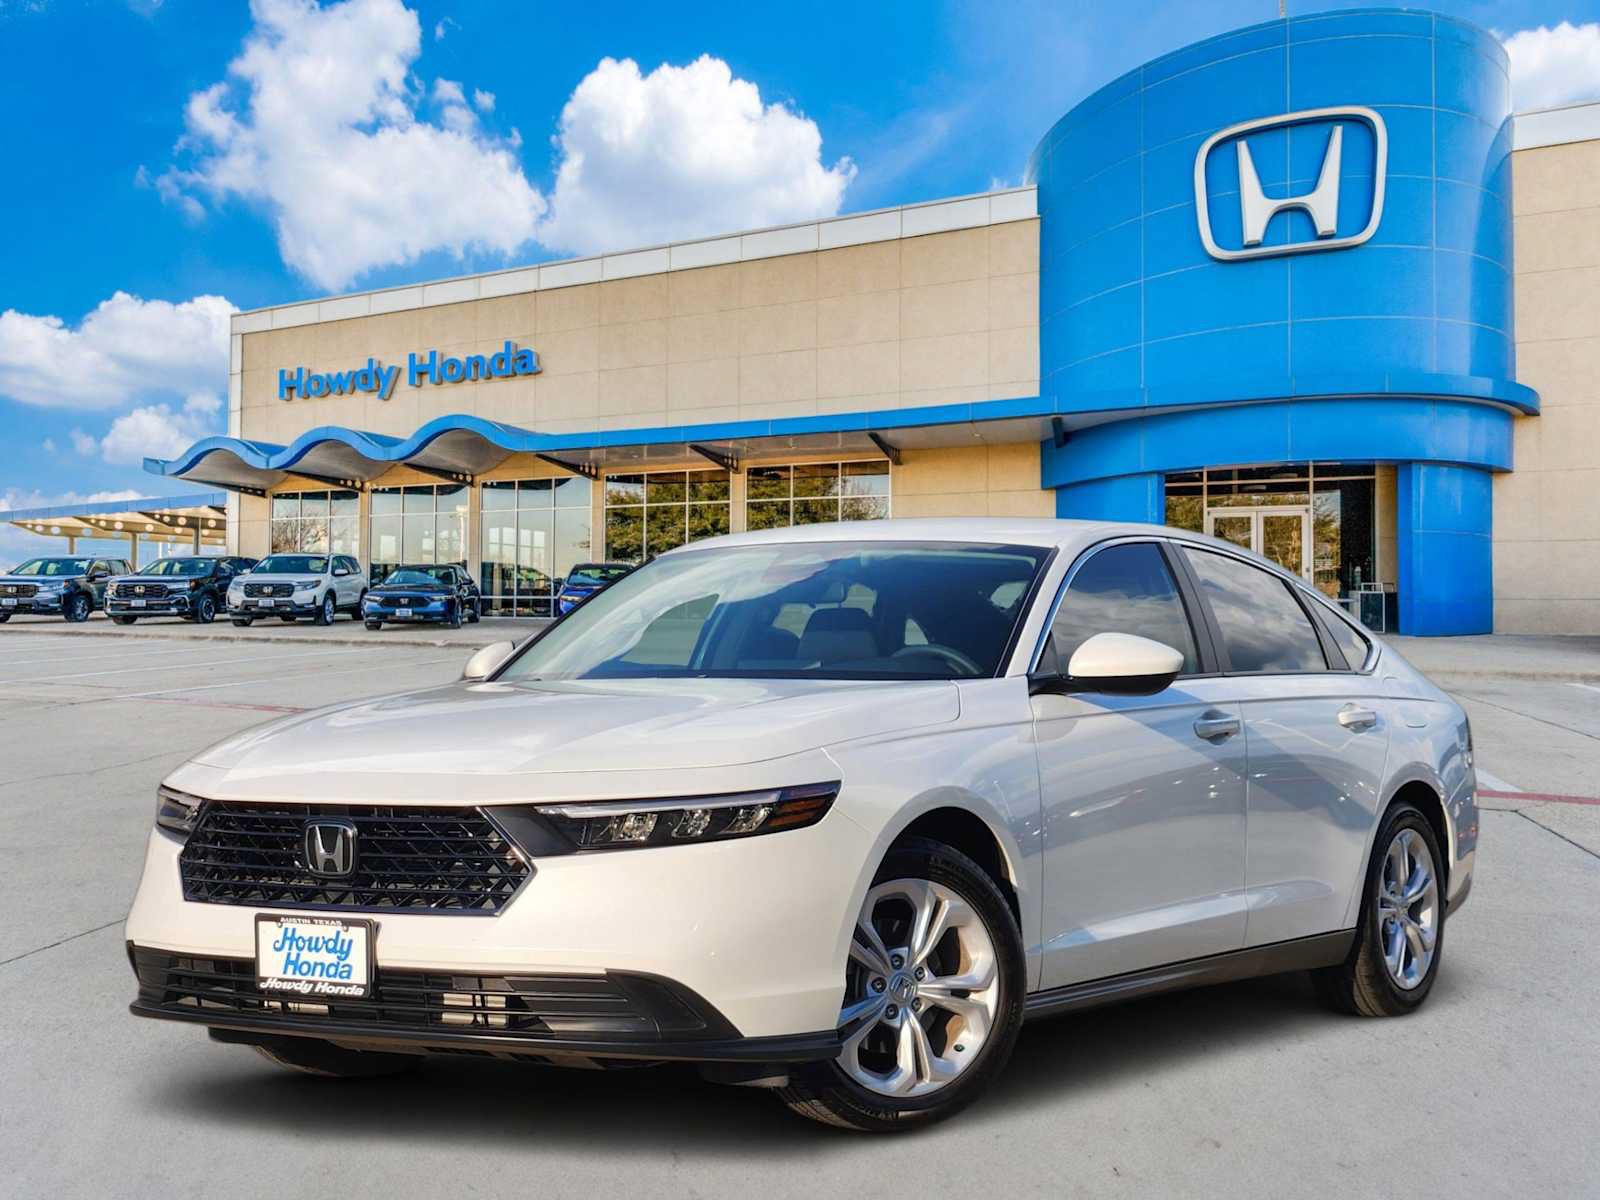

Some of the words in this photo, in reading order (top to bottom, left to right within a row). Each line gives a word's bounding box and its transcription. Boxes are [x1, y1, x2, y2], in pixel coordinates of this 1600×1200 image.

[278, 357, 400, 401] Howdy
[408, 341, 541, 387] Honda
[313, 919, 343, 927] TEXAS
[273, 927, 353, 961] Howdy
[282, 952, 353, 980] Honda
[260, 978, 314, 994] Howdy
[315, 982, 365, 996] Honda
